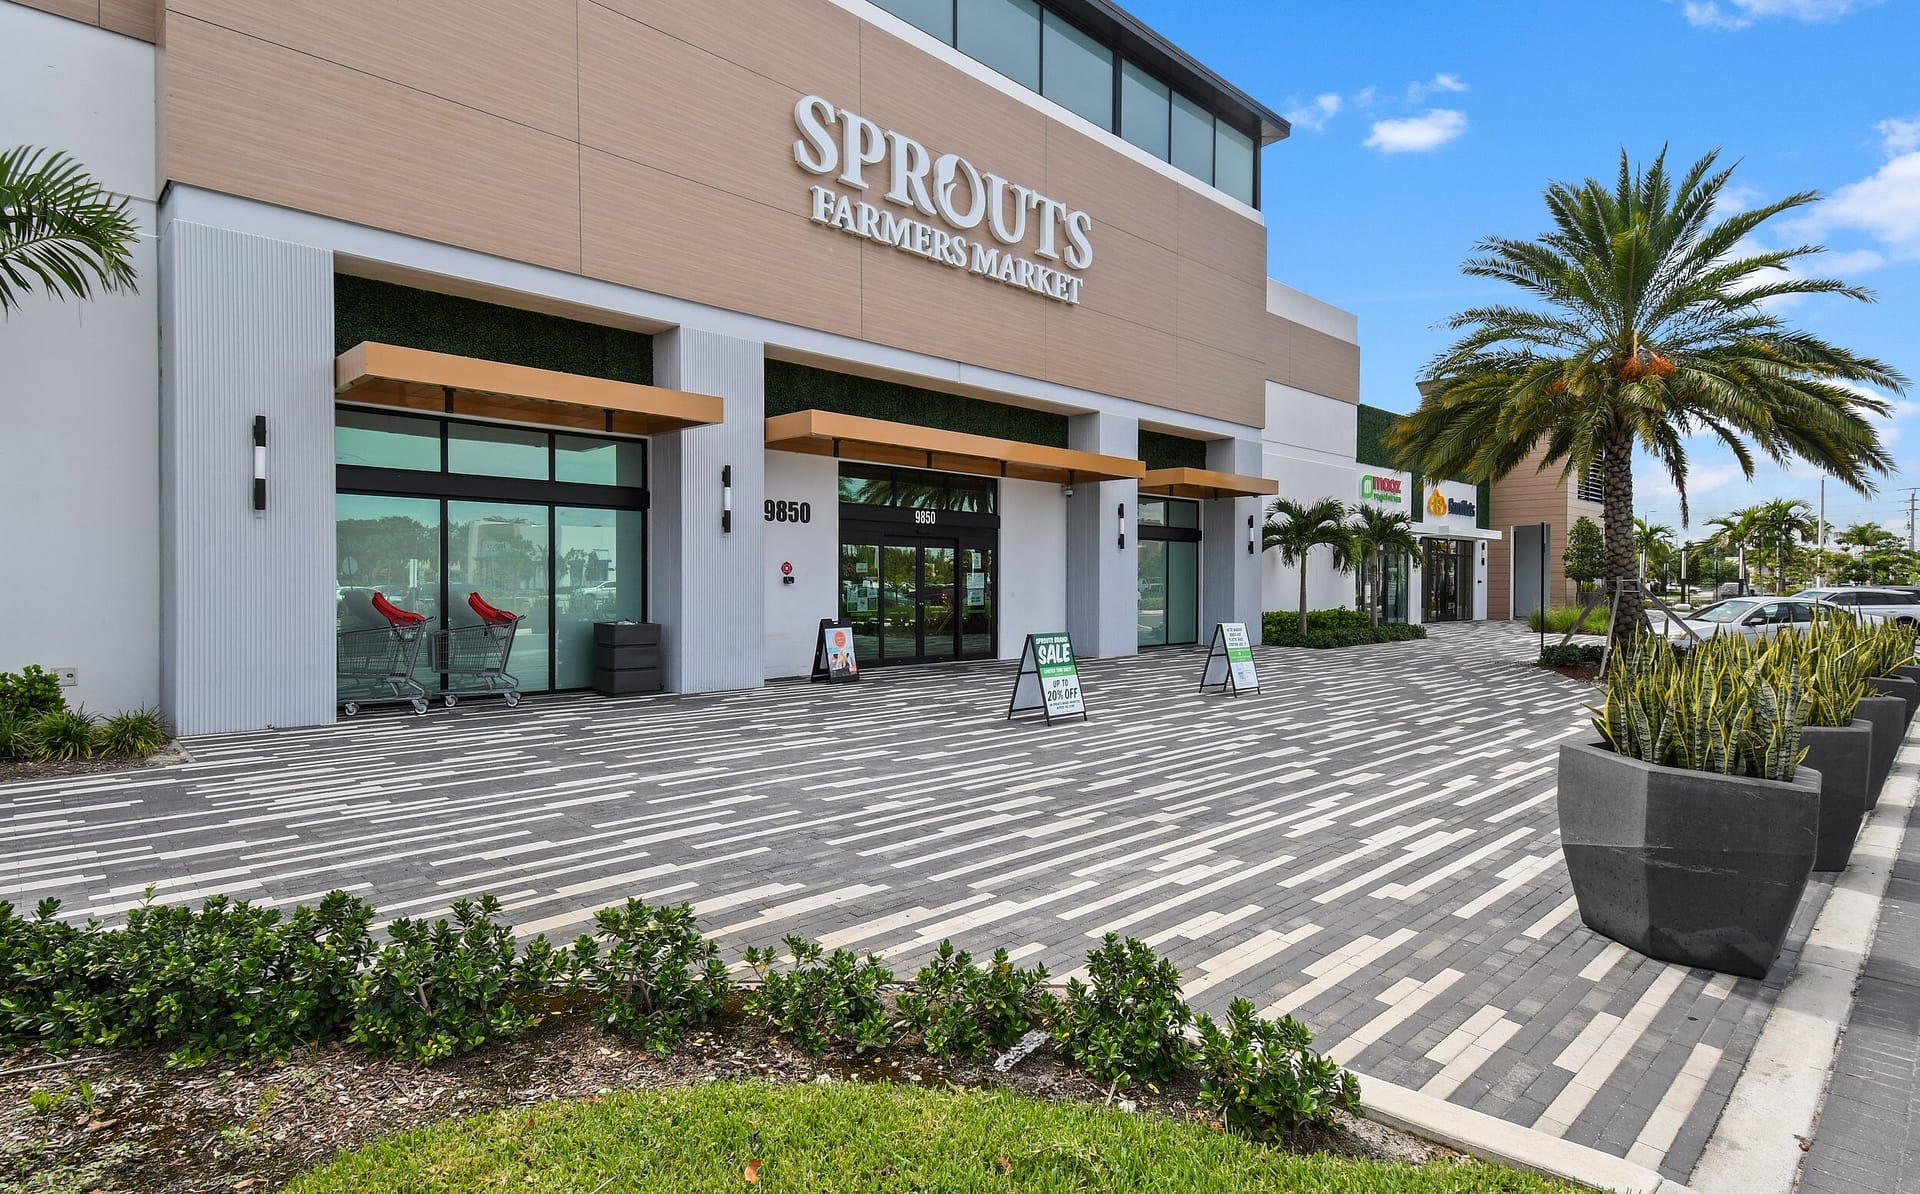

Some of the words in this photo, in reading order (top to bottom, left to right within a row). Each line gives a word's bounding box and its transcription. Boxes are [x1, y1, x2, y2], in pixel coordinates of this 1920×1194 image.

[793, 95, 1093, 270] SPROUTS
[809, 184, 968, 268] FARMERS
[968, 241, 1084, 305] MARKET
[764, 499, 811, 523] 9850
[915, 510, 936, 525] 9850
[1038, 643, 1070, 664] SALE
[1053, 680, 1061, 688] UP
[1062, 679, 1069, 687] TO
[1047, 690, 1063, 702] 20%
[1064, 688, 1078, 699] OFF
